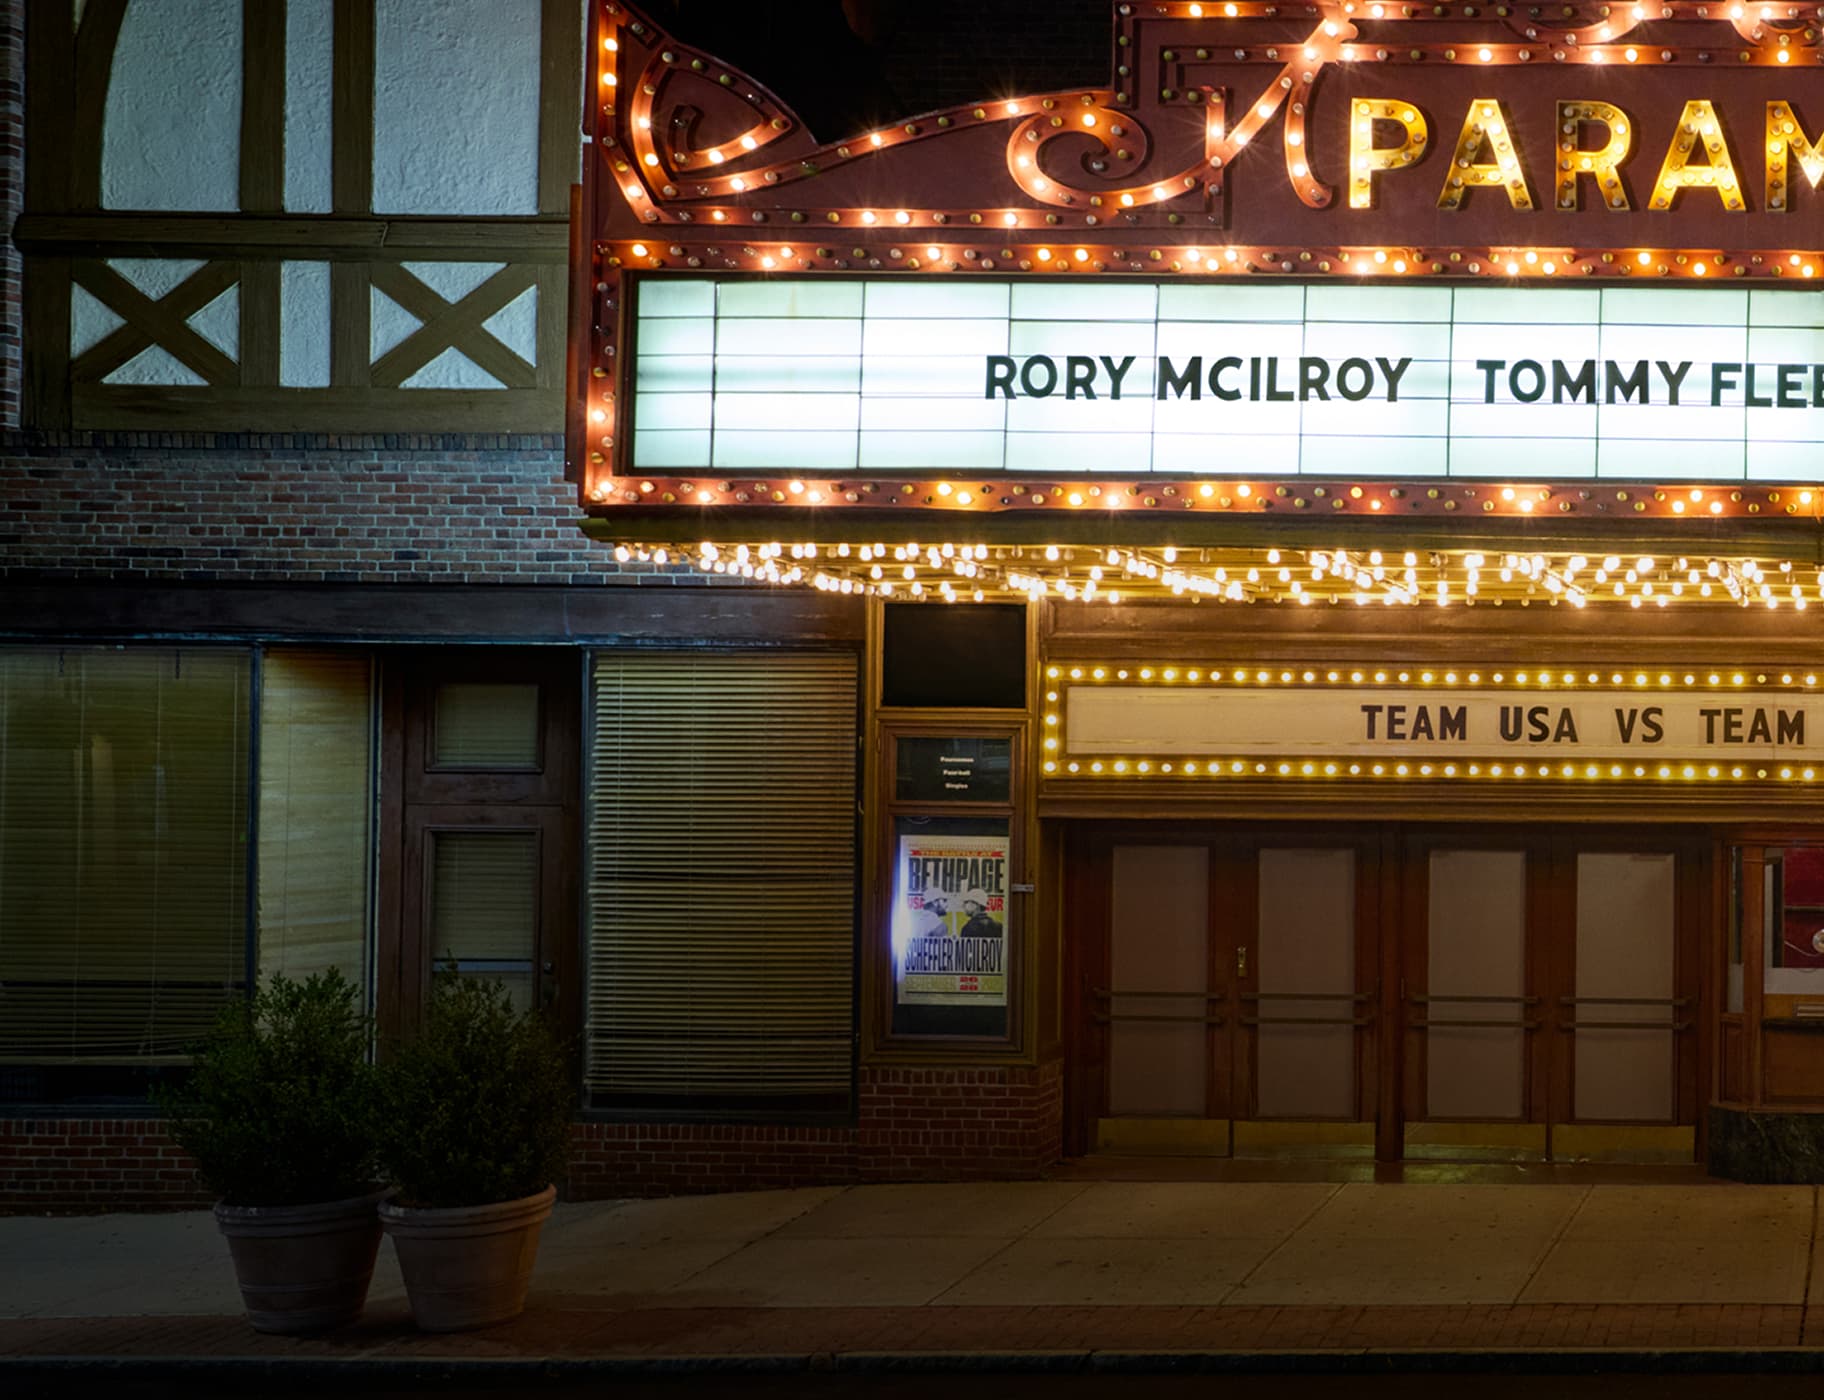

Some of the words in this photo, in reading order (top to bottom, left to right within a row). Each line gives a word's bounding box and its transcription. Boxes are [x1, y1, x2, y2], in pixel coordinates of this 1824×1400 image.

[986, 355, 1136, 400] RORY
[1158, 357, 1412, 401] MCILROY
[1477, 360, 1693, 405] TOMMY
[1362, 705, 1467, 741] TEAM
[1500, 707, 1579, 743] USA
[1616, 708, 1664, 743] VS
[1700, 709, 1805, 744] TEAM
[908, 858, 1005, 893] BETHPAGE
[906, 937, 953, 972] SCHEFFLER
[955, 938, 1003, 972] MCILROY
